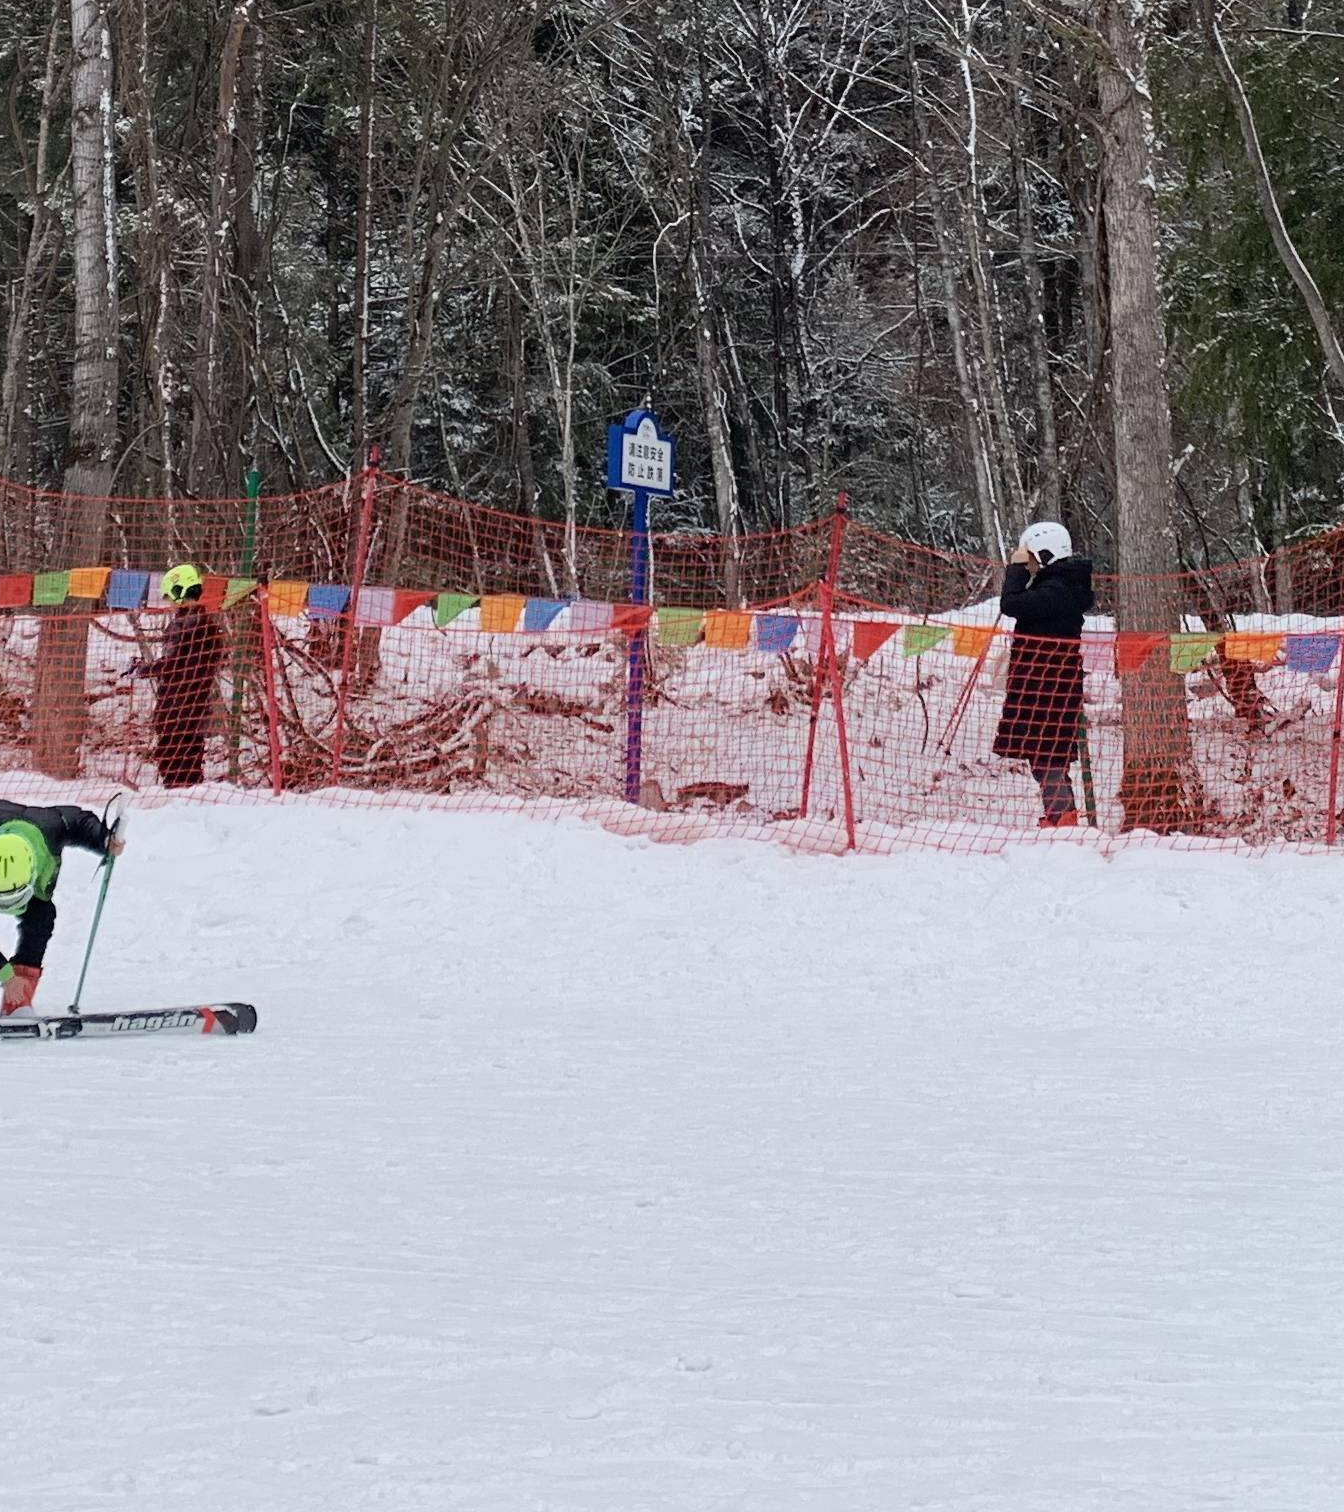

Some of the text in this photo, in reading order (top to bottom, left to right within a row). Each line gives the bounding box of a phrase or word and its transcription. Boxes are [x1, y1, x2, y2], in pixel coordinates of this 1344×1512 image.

[628, 442, 664, 462] 请注意安全
[110, 1012, 197, 1032] hagan
